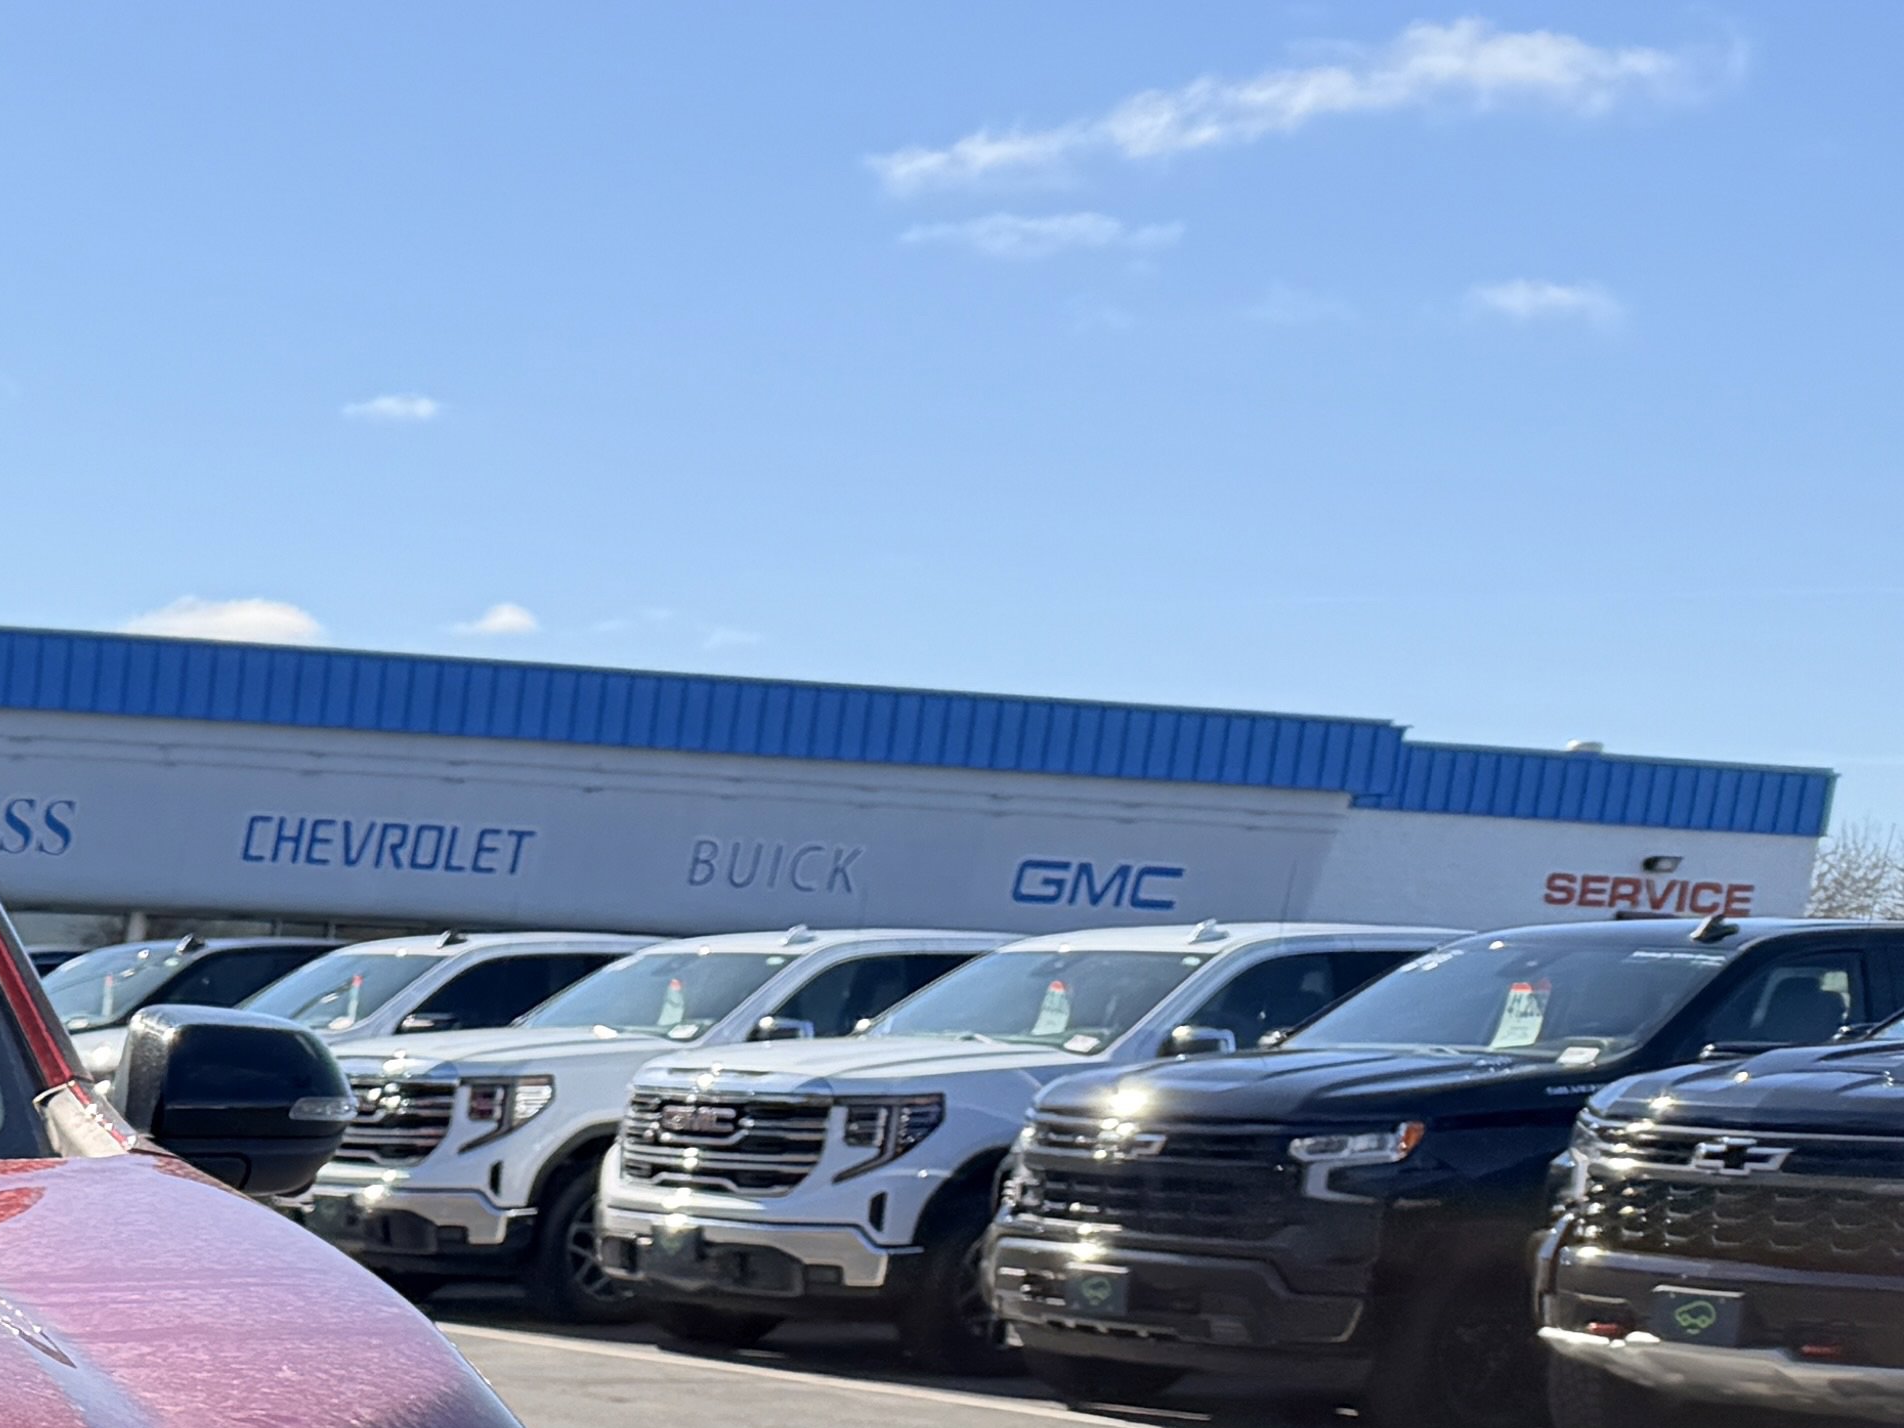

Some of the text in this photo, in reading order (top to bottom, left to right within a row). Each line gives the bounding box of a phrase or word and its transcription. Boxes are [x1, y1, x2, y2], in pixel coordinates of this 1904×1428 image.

[242, 815, 537, 875] CHEVROLET
[688, 840, 863, 894] BUICK
[1012, 860, 1185, 910] GMC
[1544, 872, 1755, 916] SERVICE
